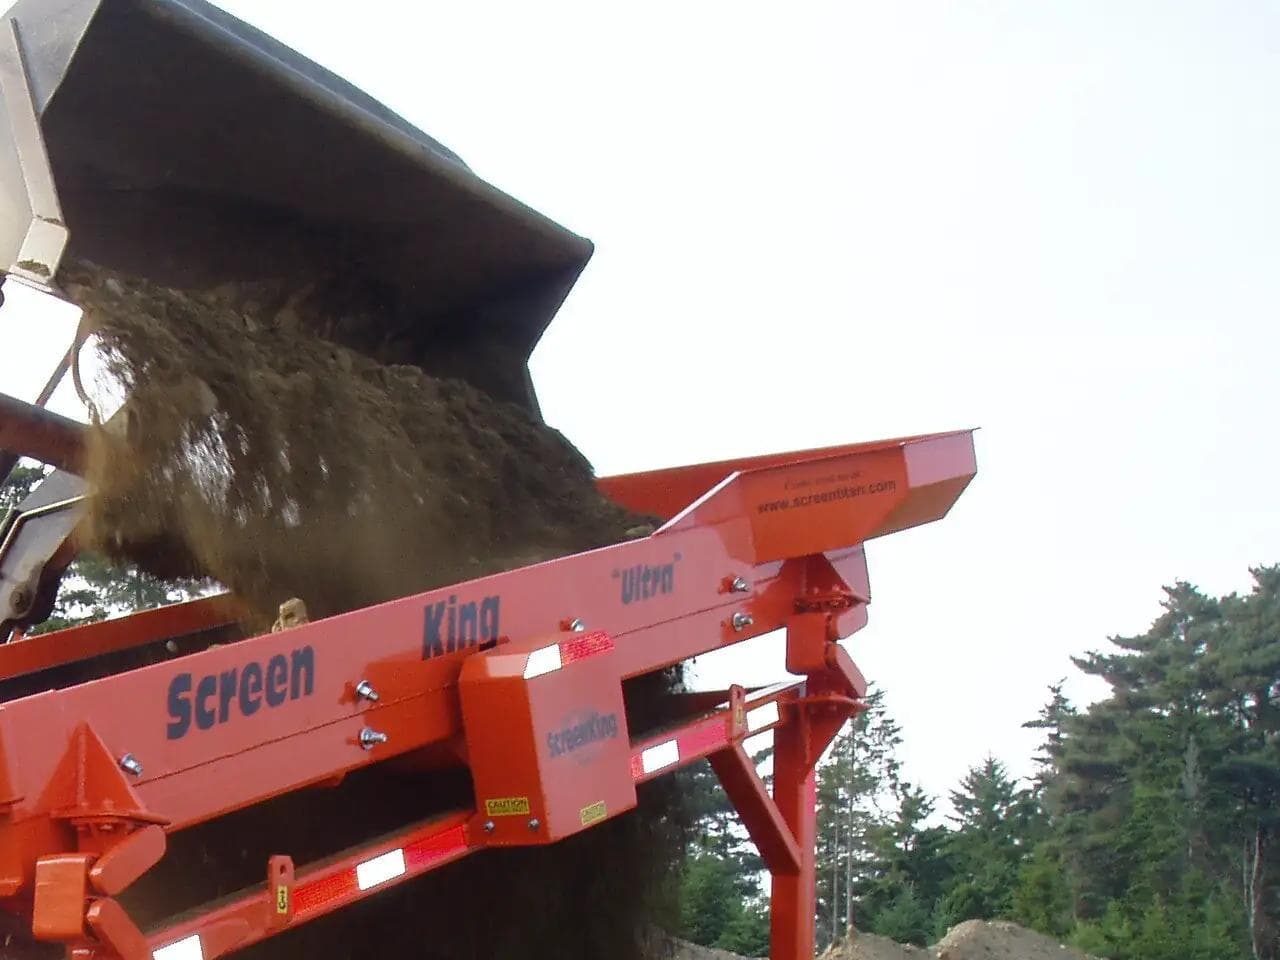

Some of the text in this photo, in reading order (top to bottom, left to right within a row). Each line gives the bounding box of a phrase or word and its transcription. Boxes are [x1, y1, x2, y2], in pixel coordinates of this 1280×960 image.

[166, 624, 315, 741] Screen
[423, 595, 500, 660] King
[547, 712, 618, 758] ScreenKing
[487, 799, 528, 809] CAUTION
